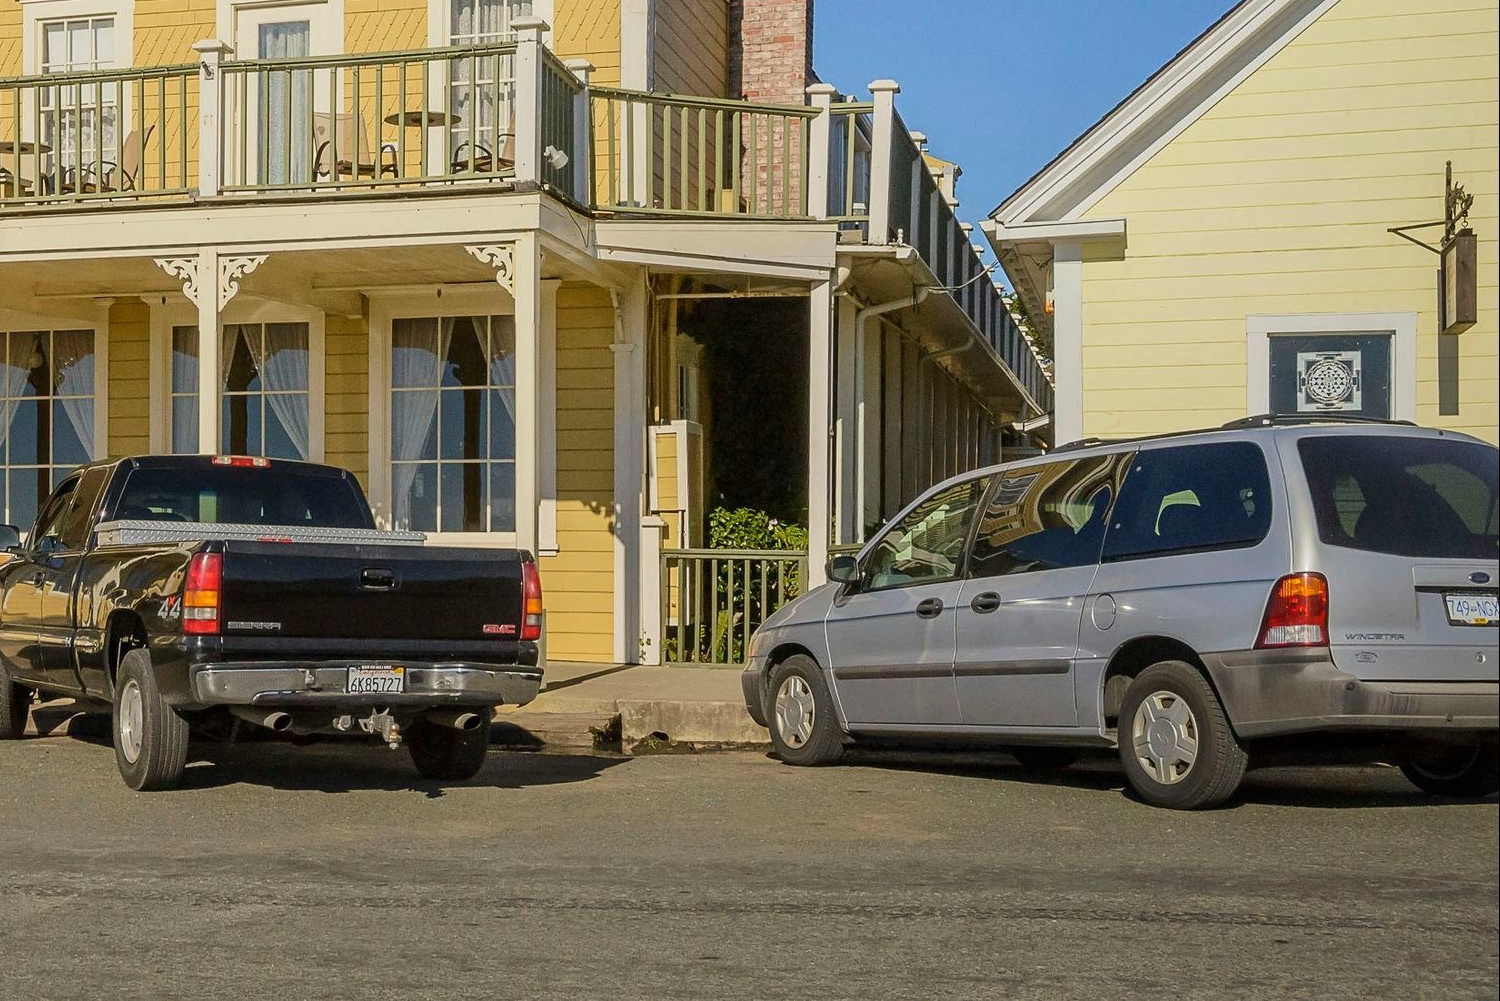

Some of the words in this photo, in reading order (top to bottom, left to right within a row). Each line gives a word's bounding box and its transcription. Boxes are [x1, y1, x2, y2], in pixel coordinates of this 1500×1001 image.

[227, 621, 281, 630] SIERRA
[483, 624, 516, 634] GMC
[350, 677, 402, 692] 6K85727
